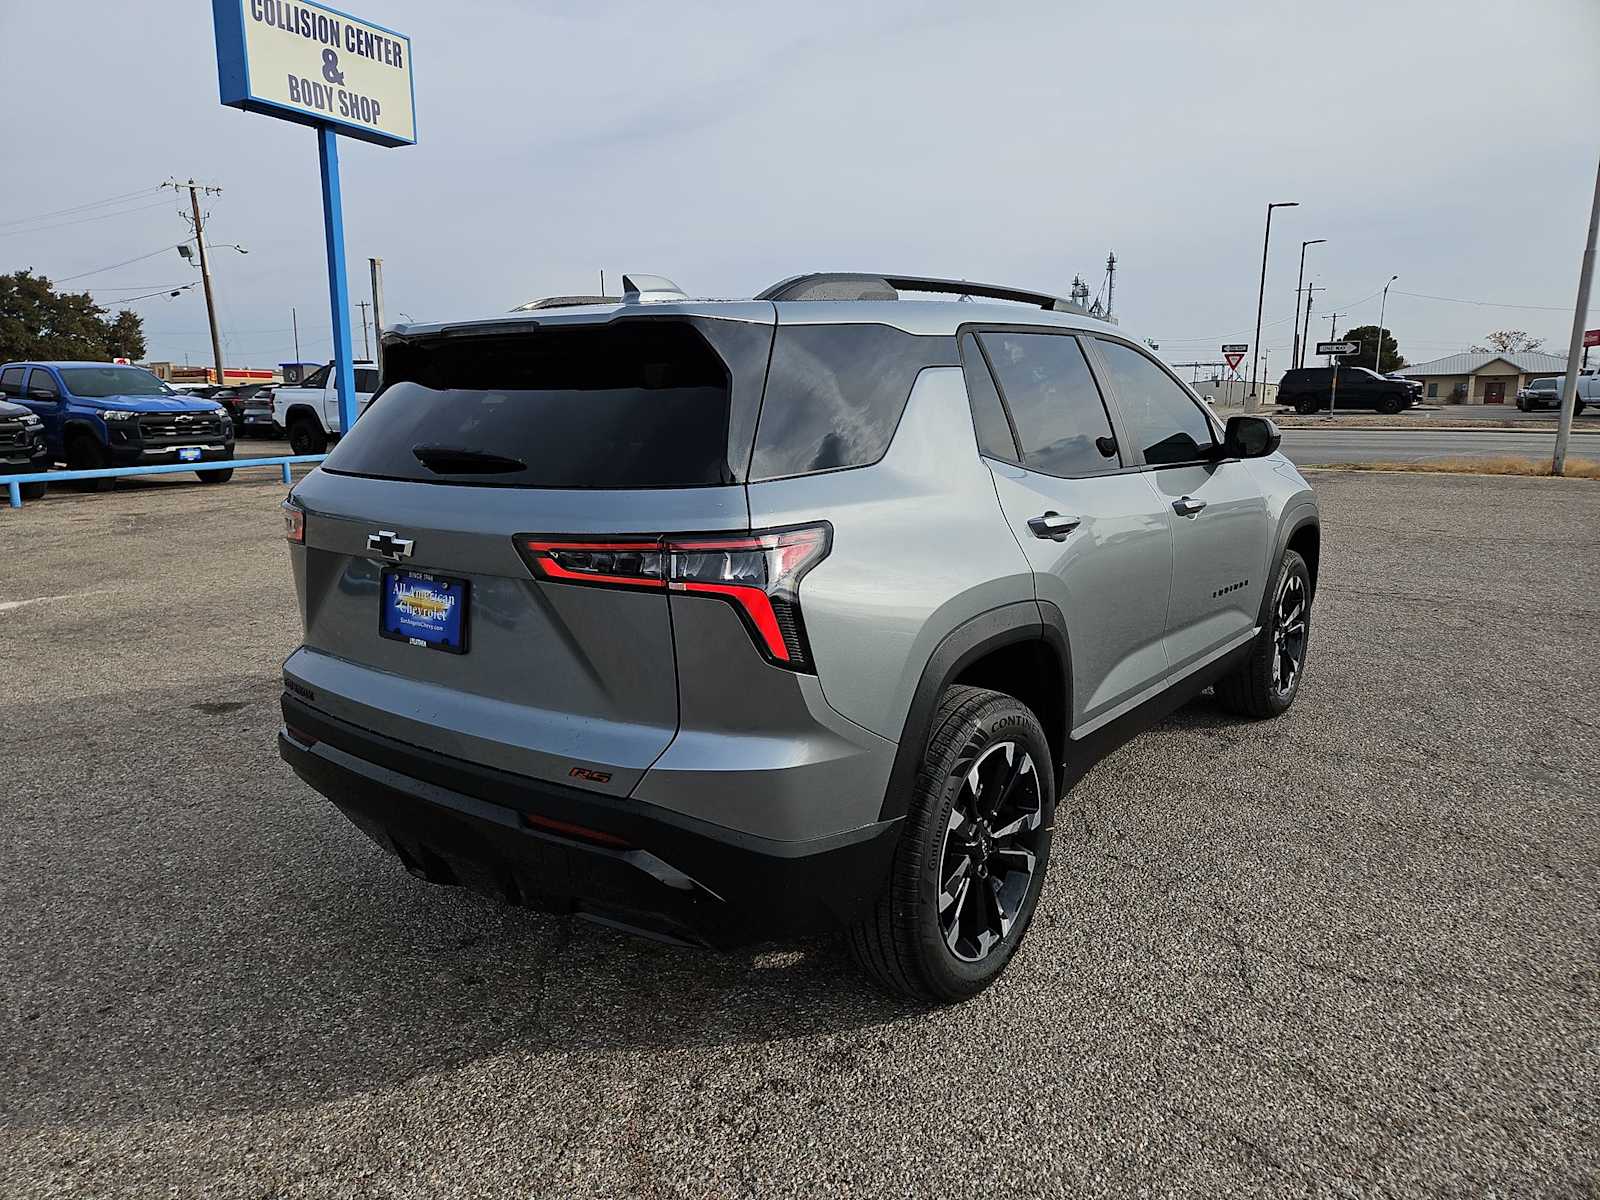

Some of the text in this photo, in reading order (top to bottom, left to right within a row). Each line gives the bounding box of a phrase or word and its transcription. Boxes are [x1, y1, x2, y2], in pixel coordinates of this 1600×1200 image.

[251, 0, 403, 68] COLLISION CENTER
[321, 48, 345, 86] &
[288, 73, 381, 125] BODY SHOP
[392, 582, 455, 606] All American
[399, 600, 448, 622] Chevrolet
